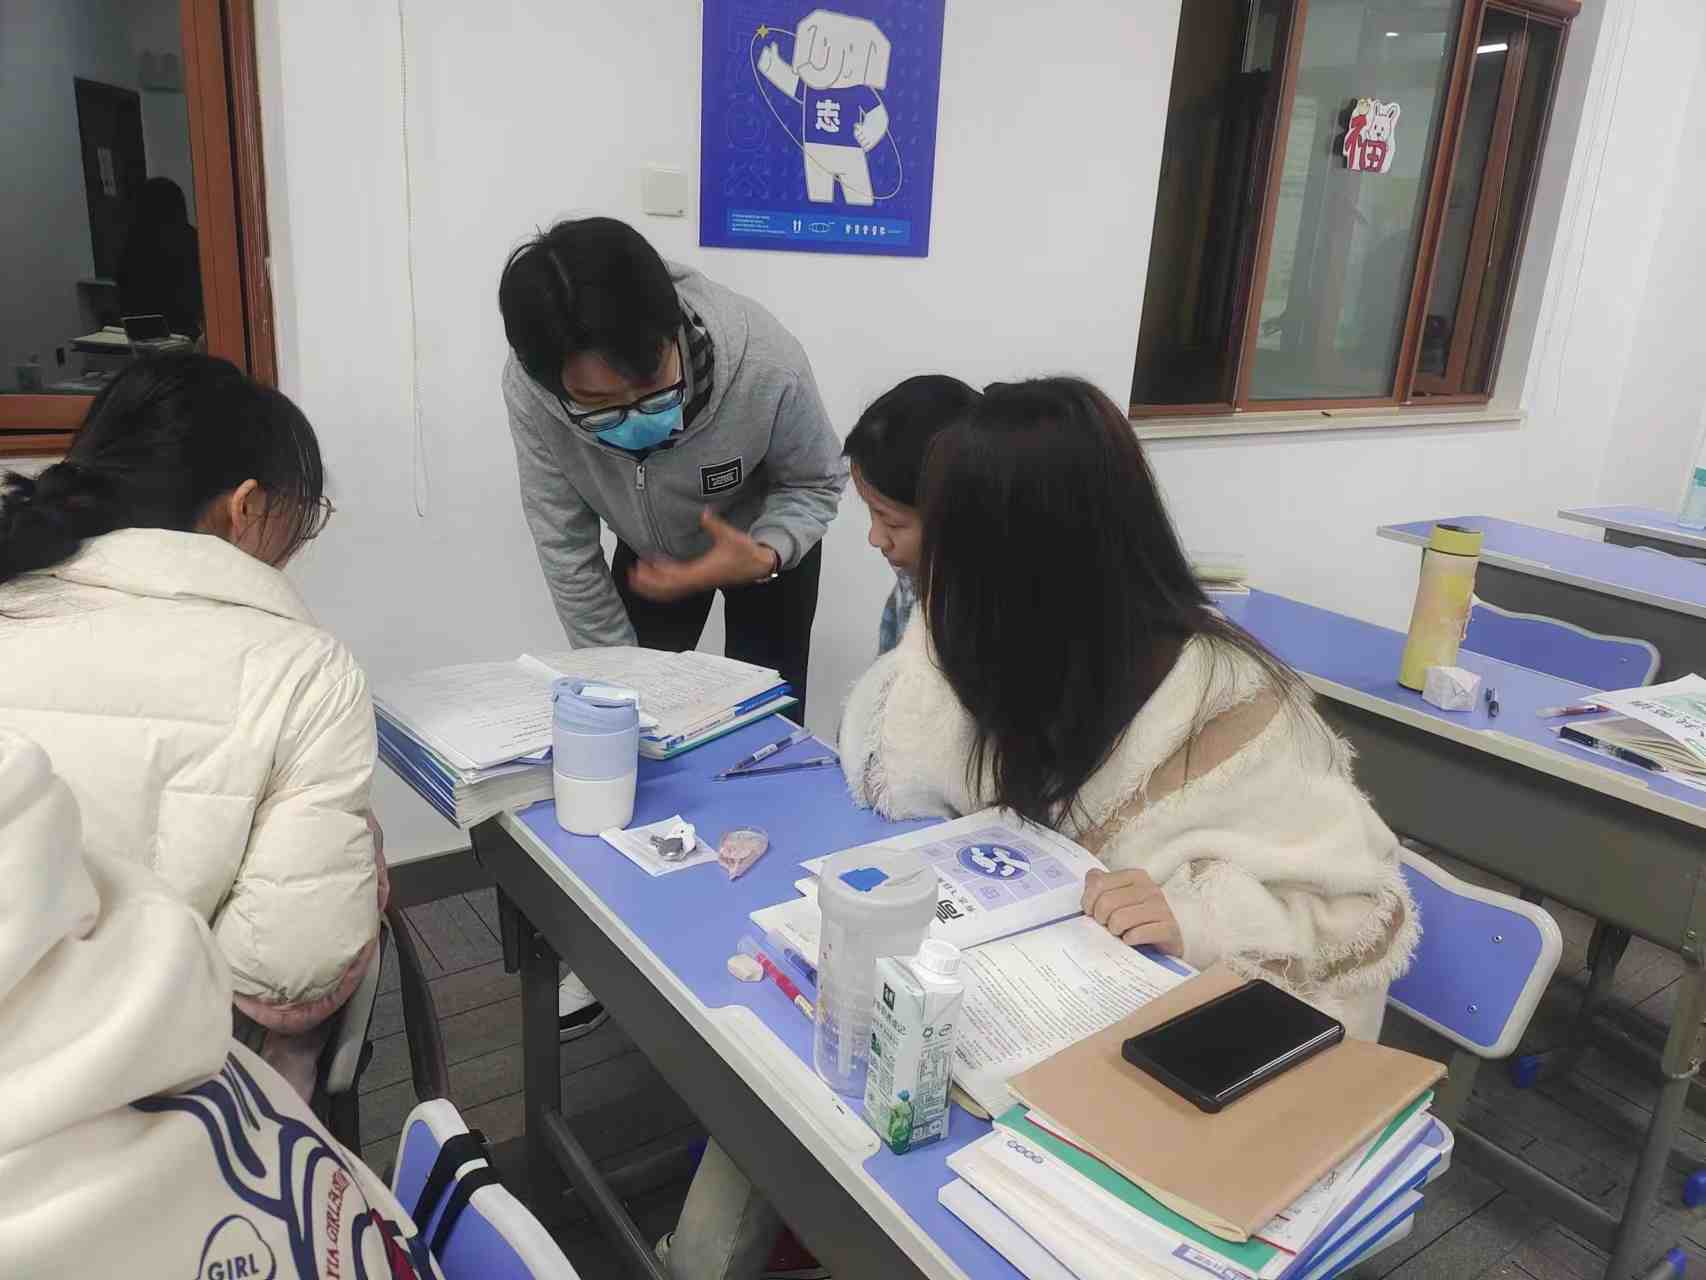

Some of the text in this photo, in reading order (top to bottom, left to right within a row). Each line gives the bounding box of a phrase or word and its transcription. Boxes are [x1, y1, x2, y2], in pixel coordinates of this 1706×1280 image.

[816, 99, 840, 133] 志
[1344, 97, 1390, 173] 福
[208, 1253, 260, 1280] GIRL
